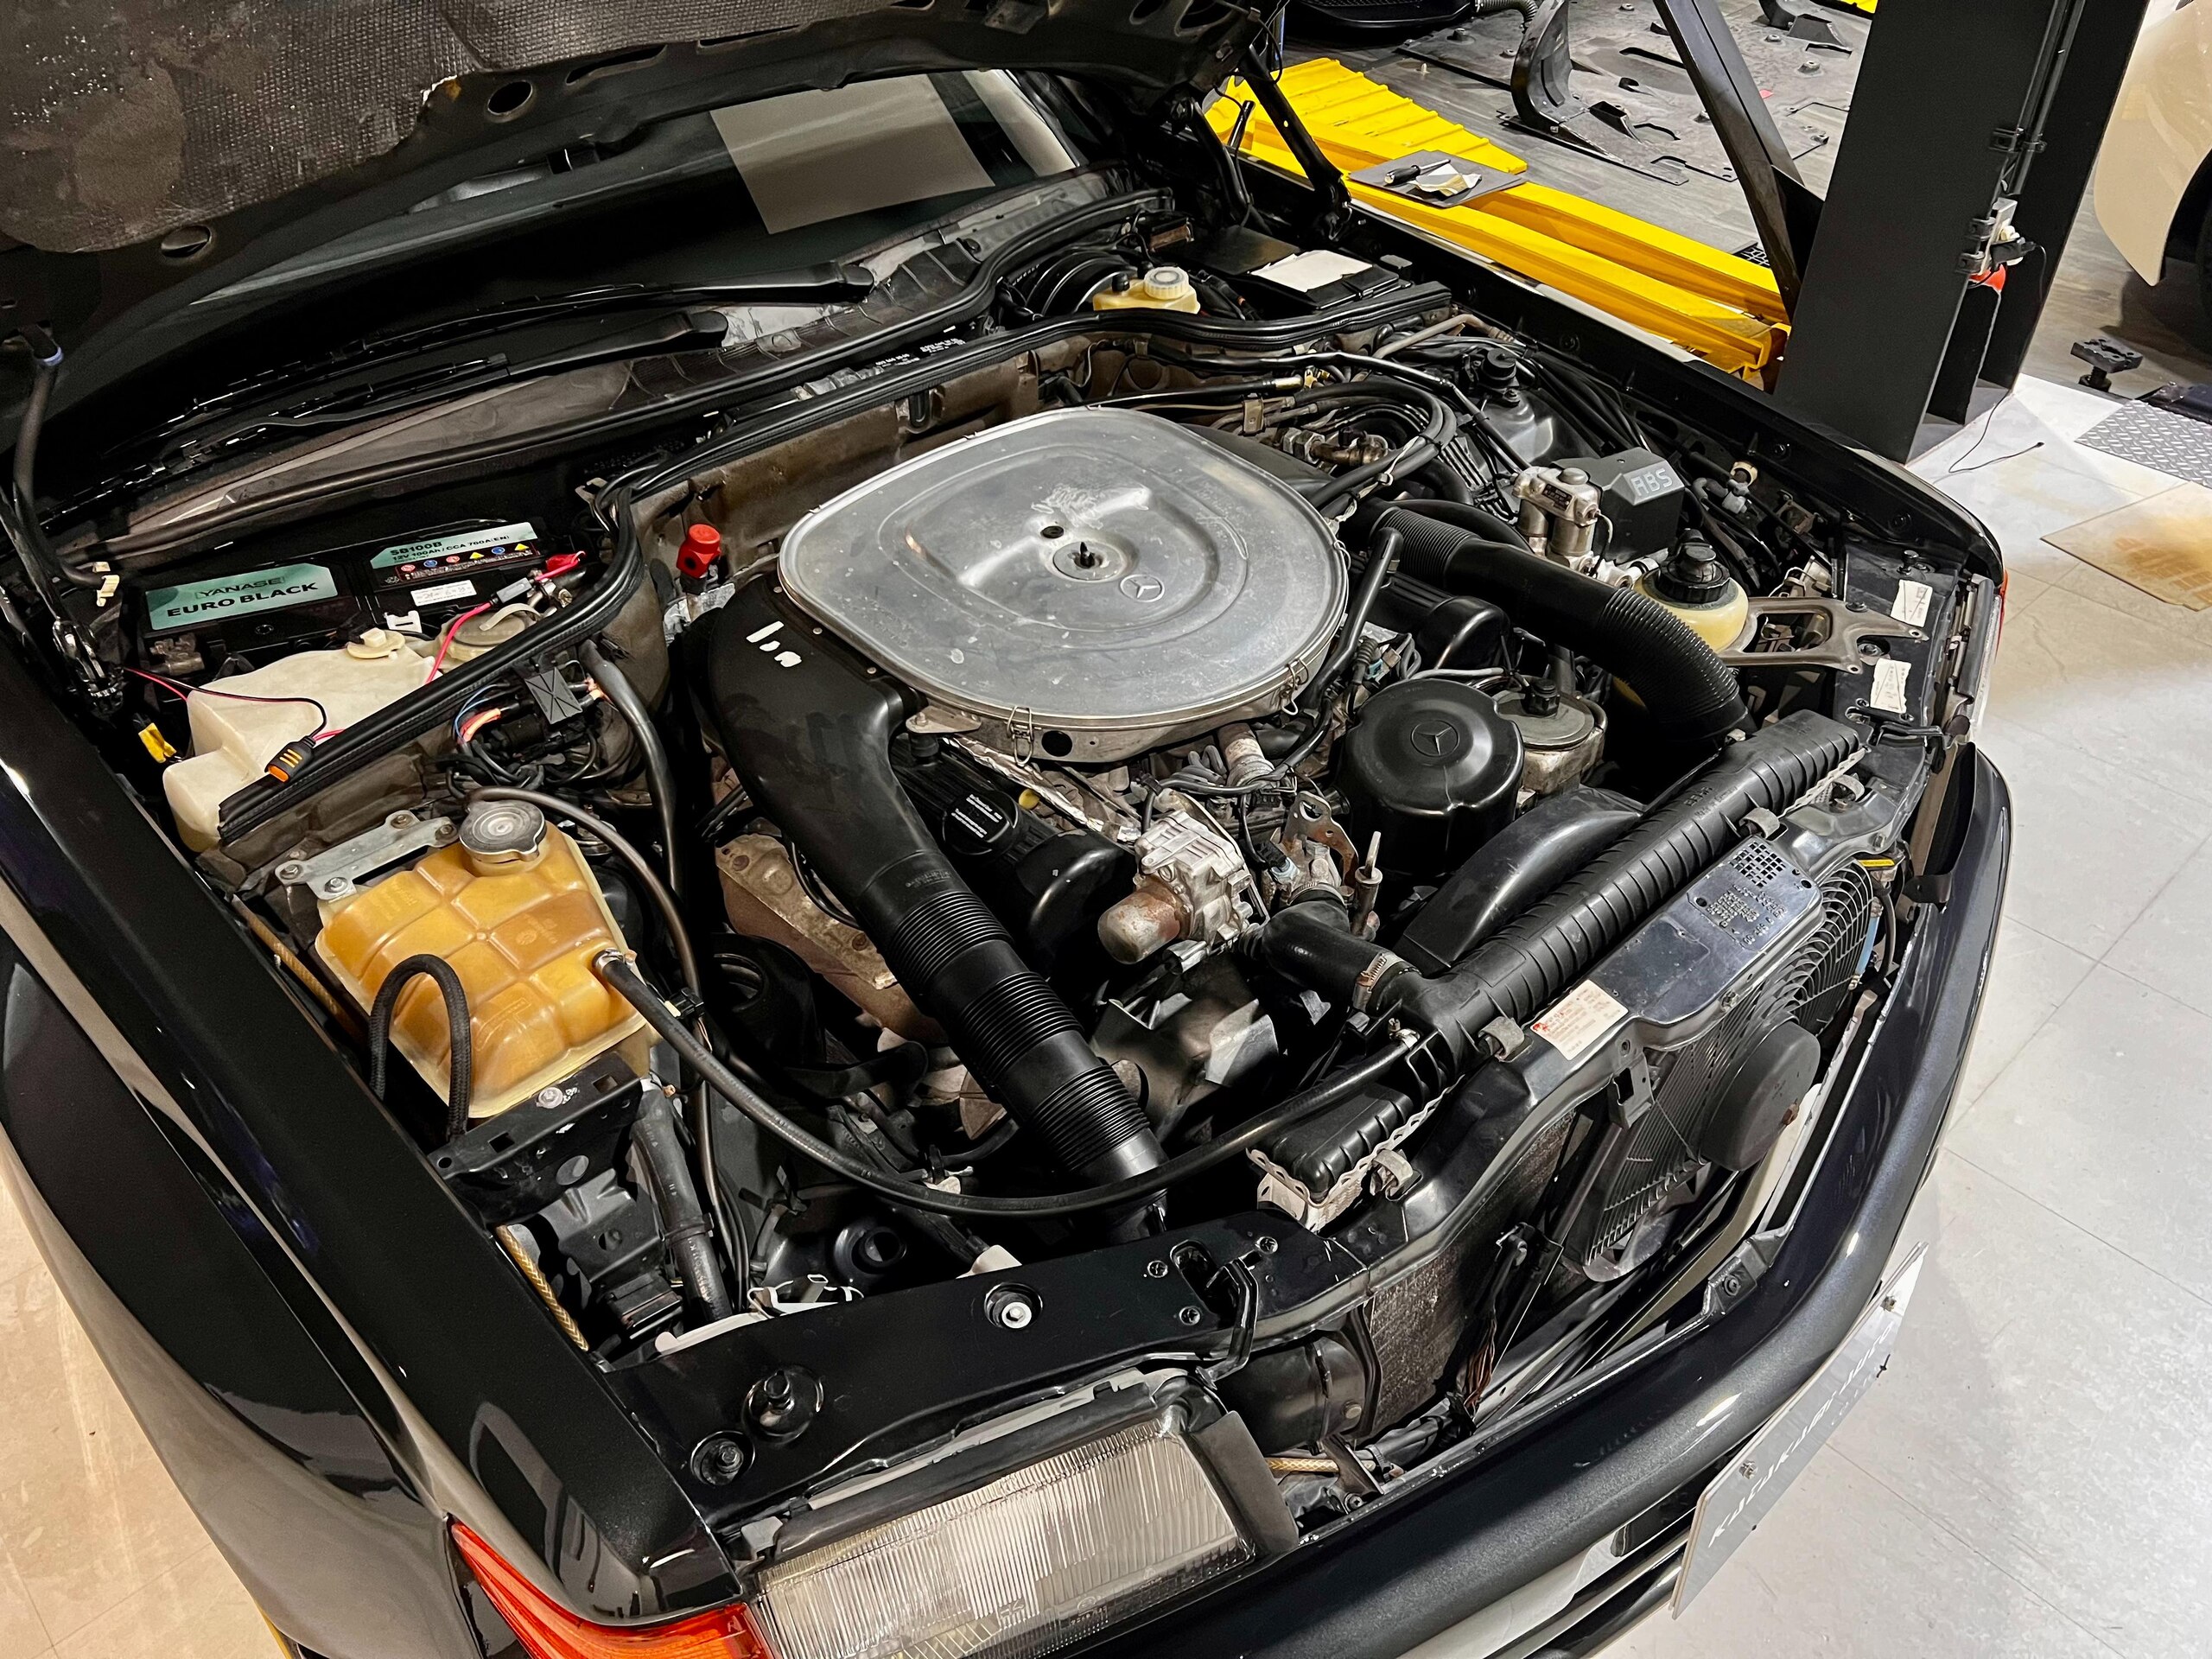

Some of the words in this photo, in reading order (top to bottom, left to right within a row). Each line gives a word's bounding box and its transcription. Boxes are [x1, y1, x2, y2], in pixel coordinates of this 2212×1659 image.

[1630, 468, 1673, 496] ABS
[391, 542, 442, 555] SB100B
[199, 577, 281, 597] YANASE
[167, 598, 235, 617] EURO
[240, 582, 318, 603] BLACK
